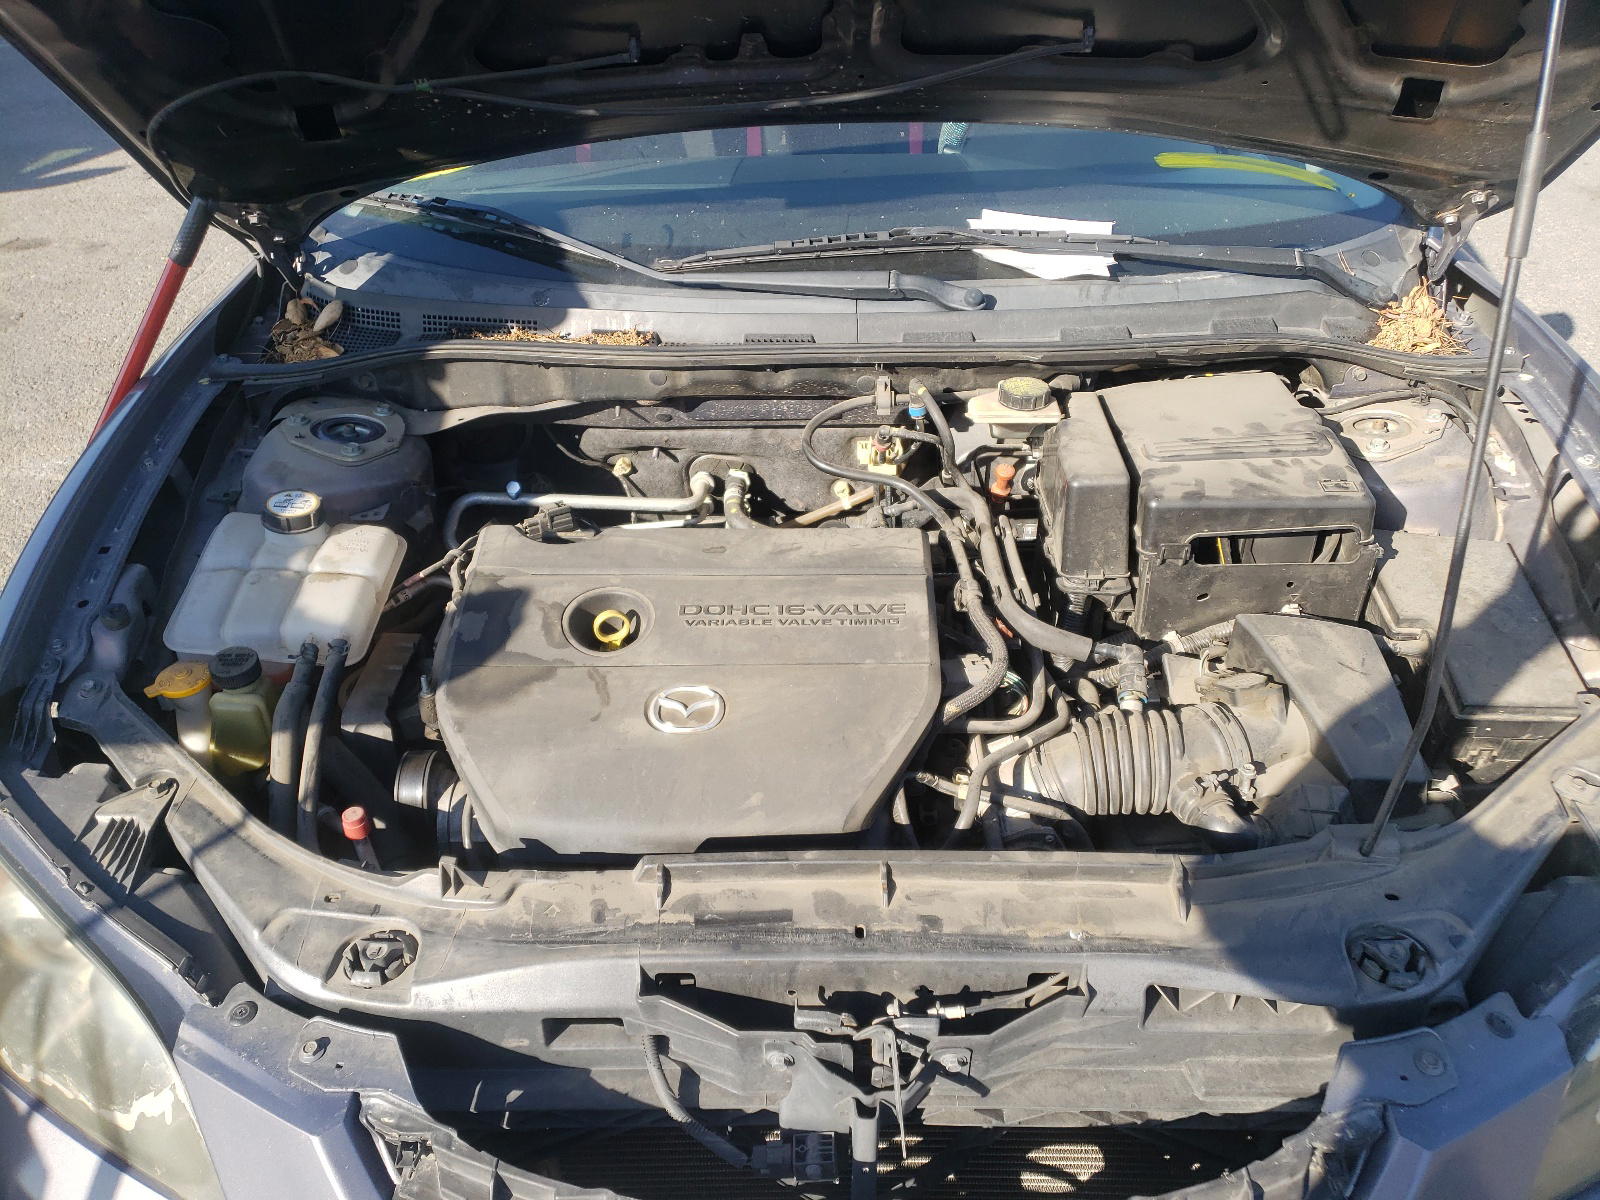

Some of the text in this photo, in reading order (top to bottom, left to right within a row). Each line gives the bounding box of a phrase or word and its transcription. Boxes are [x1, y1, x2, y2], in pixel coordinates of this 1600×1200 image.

[679, 603, 907, 616] DOHC 16-VALVE
[684, 617, 900, 627] VARIABLE VALVE TIMING
